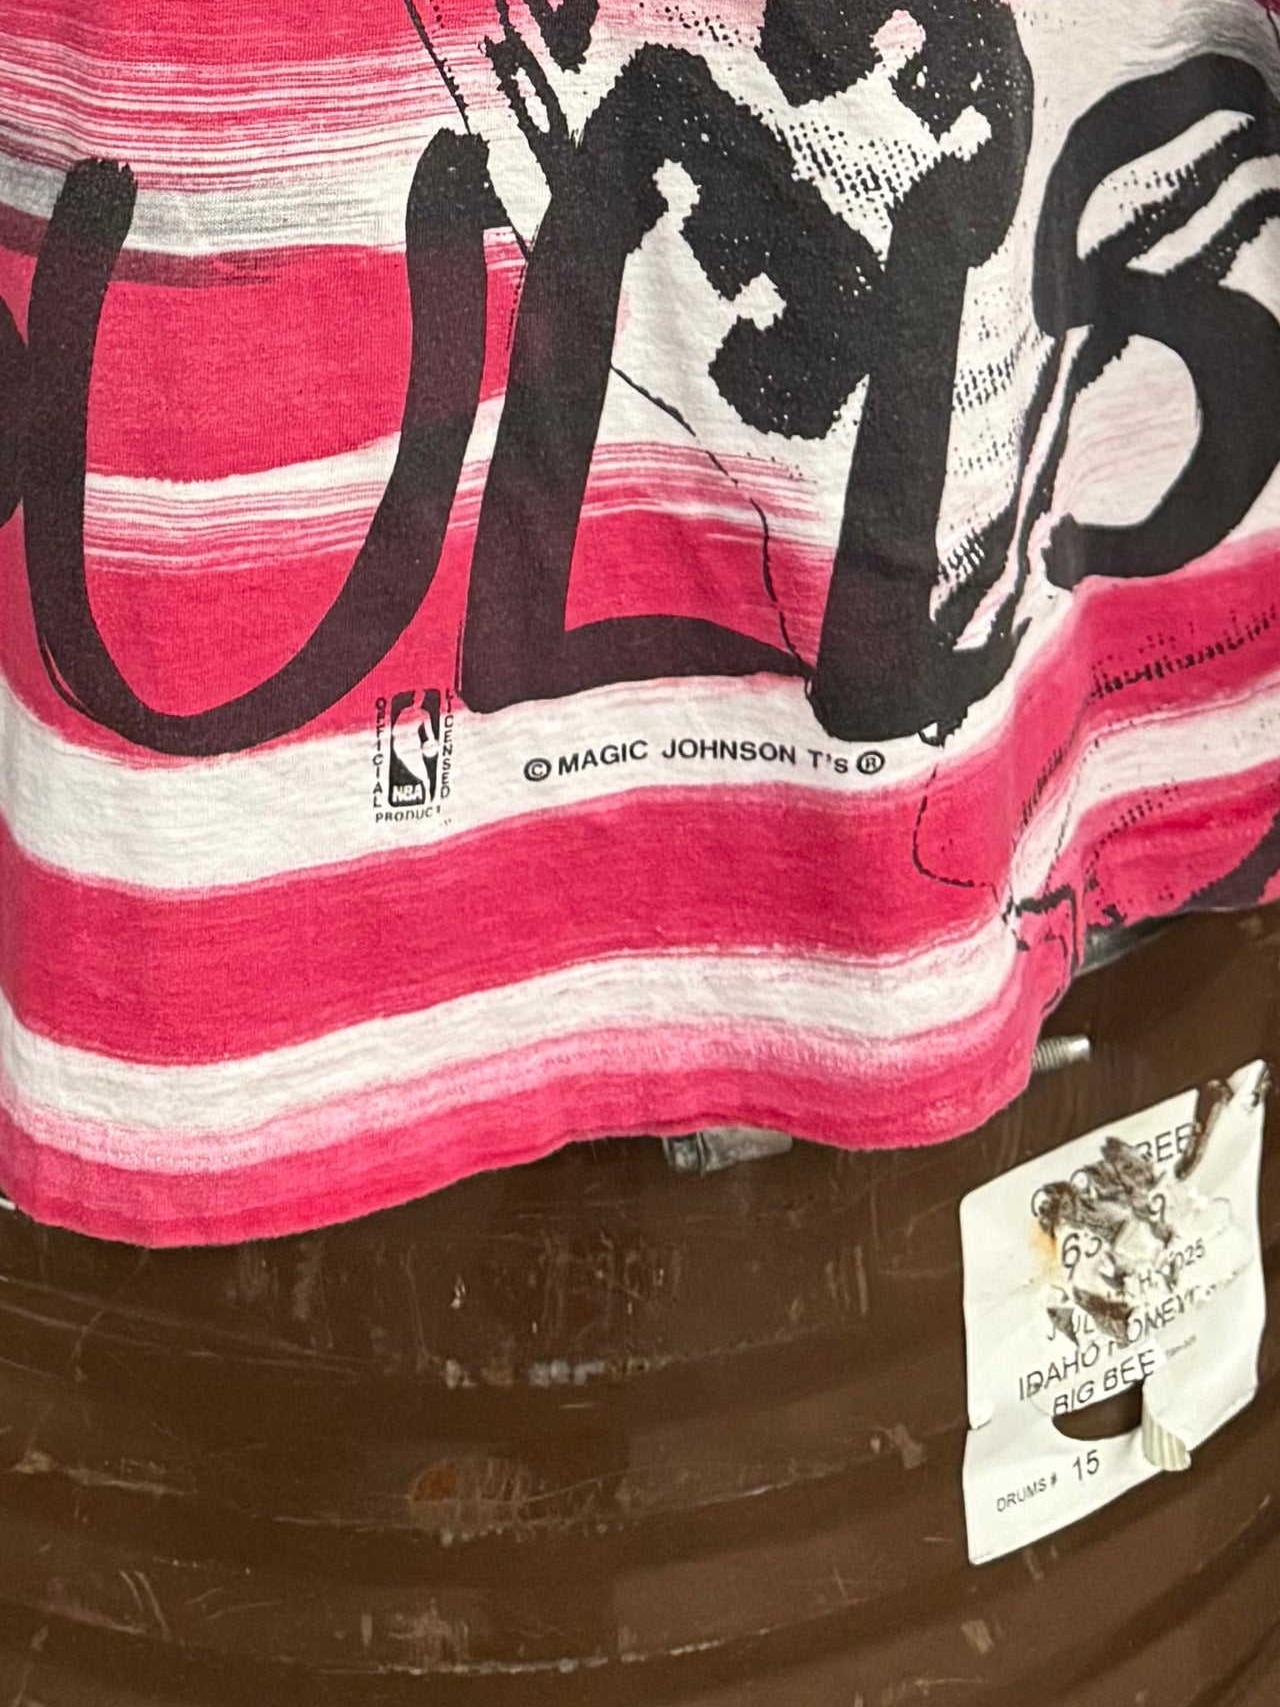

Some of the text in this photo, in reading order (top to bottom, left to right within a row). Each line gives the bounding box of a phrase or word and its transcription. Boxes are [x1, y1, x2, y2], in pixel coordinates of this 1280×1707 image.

[440, 688, 455, 798] LICENSED
[557, 739, 650, 775] MAGIC
[661, 739, 796, 764] JOHNSON
[391, 784, 423, 803] NBA
[1017, 1337, 1100, 1403] IDAHO
[1052, 1349, 1157, 1417] BIG BEE
[996, 1477, 1048, 1513] DRUMS
[1072, 1450, 1102, 1483] 15
